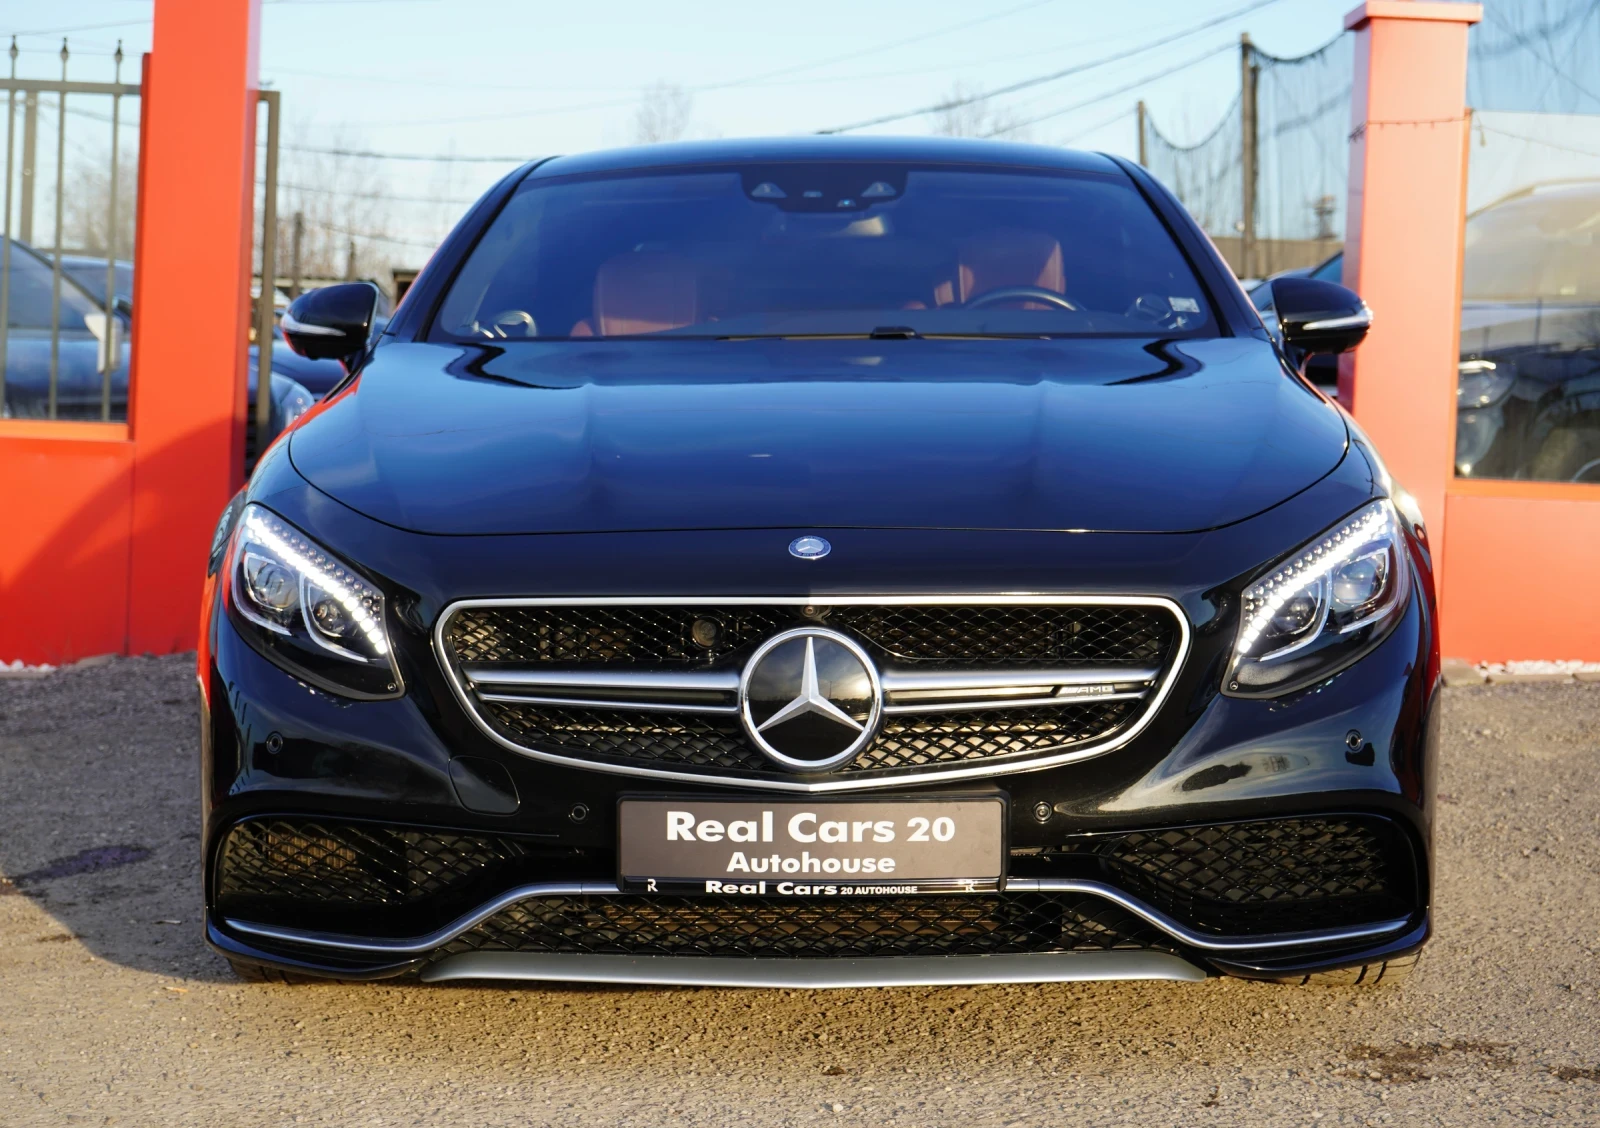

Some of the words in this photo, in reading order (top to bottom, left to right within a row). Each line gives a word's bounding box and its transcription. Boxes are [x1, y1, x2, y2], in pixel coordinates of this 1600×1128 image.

[666, 811, 773, 843] Real
[787, 812, 896, 843] Cars
[906, 816, 956, 842] 20
[726, 851, 896, 873] Autohouse
[705, 880, 766, 895] Real
[776, 882, 838, 896] Cars
[840, 886, 854, 895] 20
[854, 886, 918, 895] AUTOHOUSE
